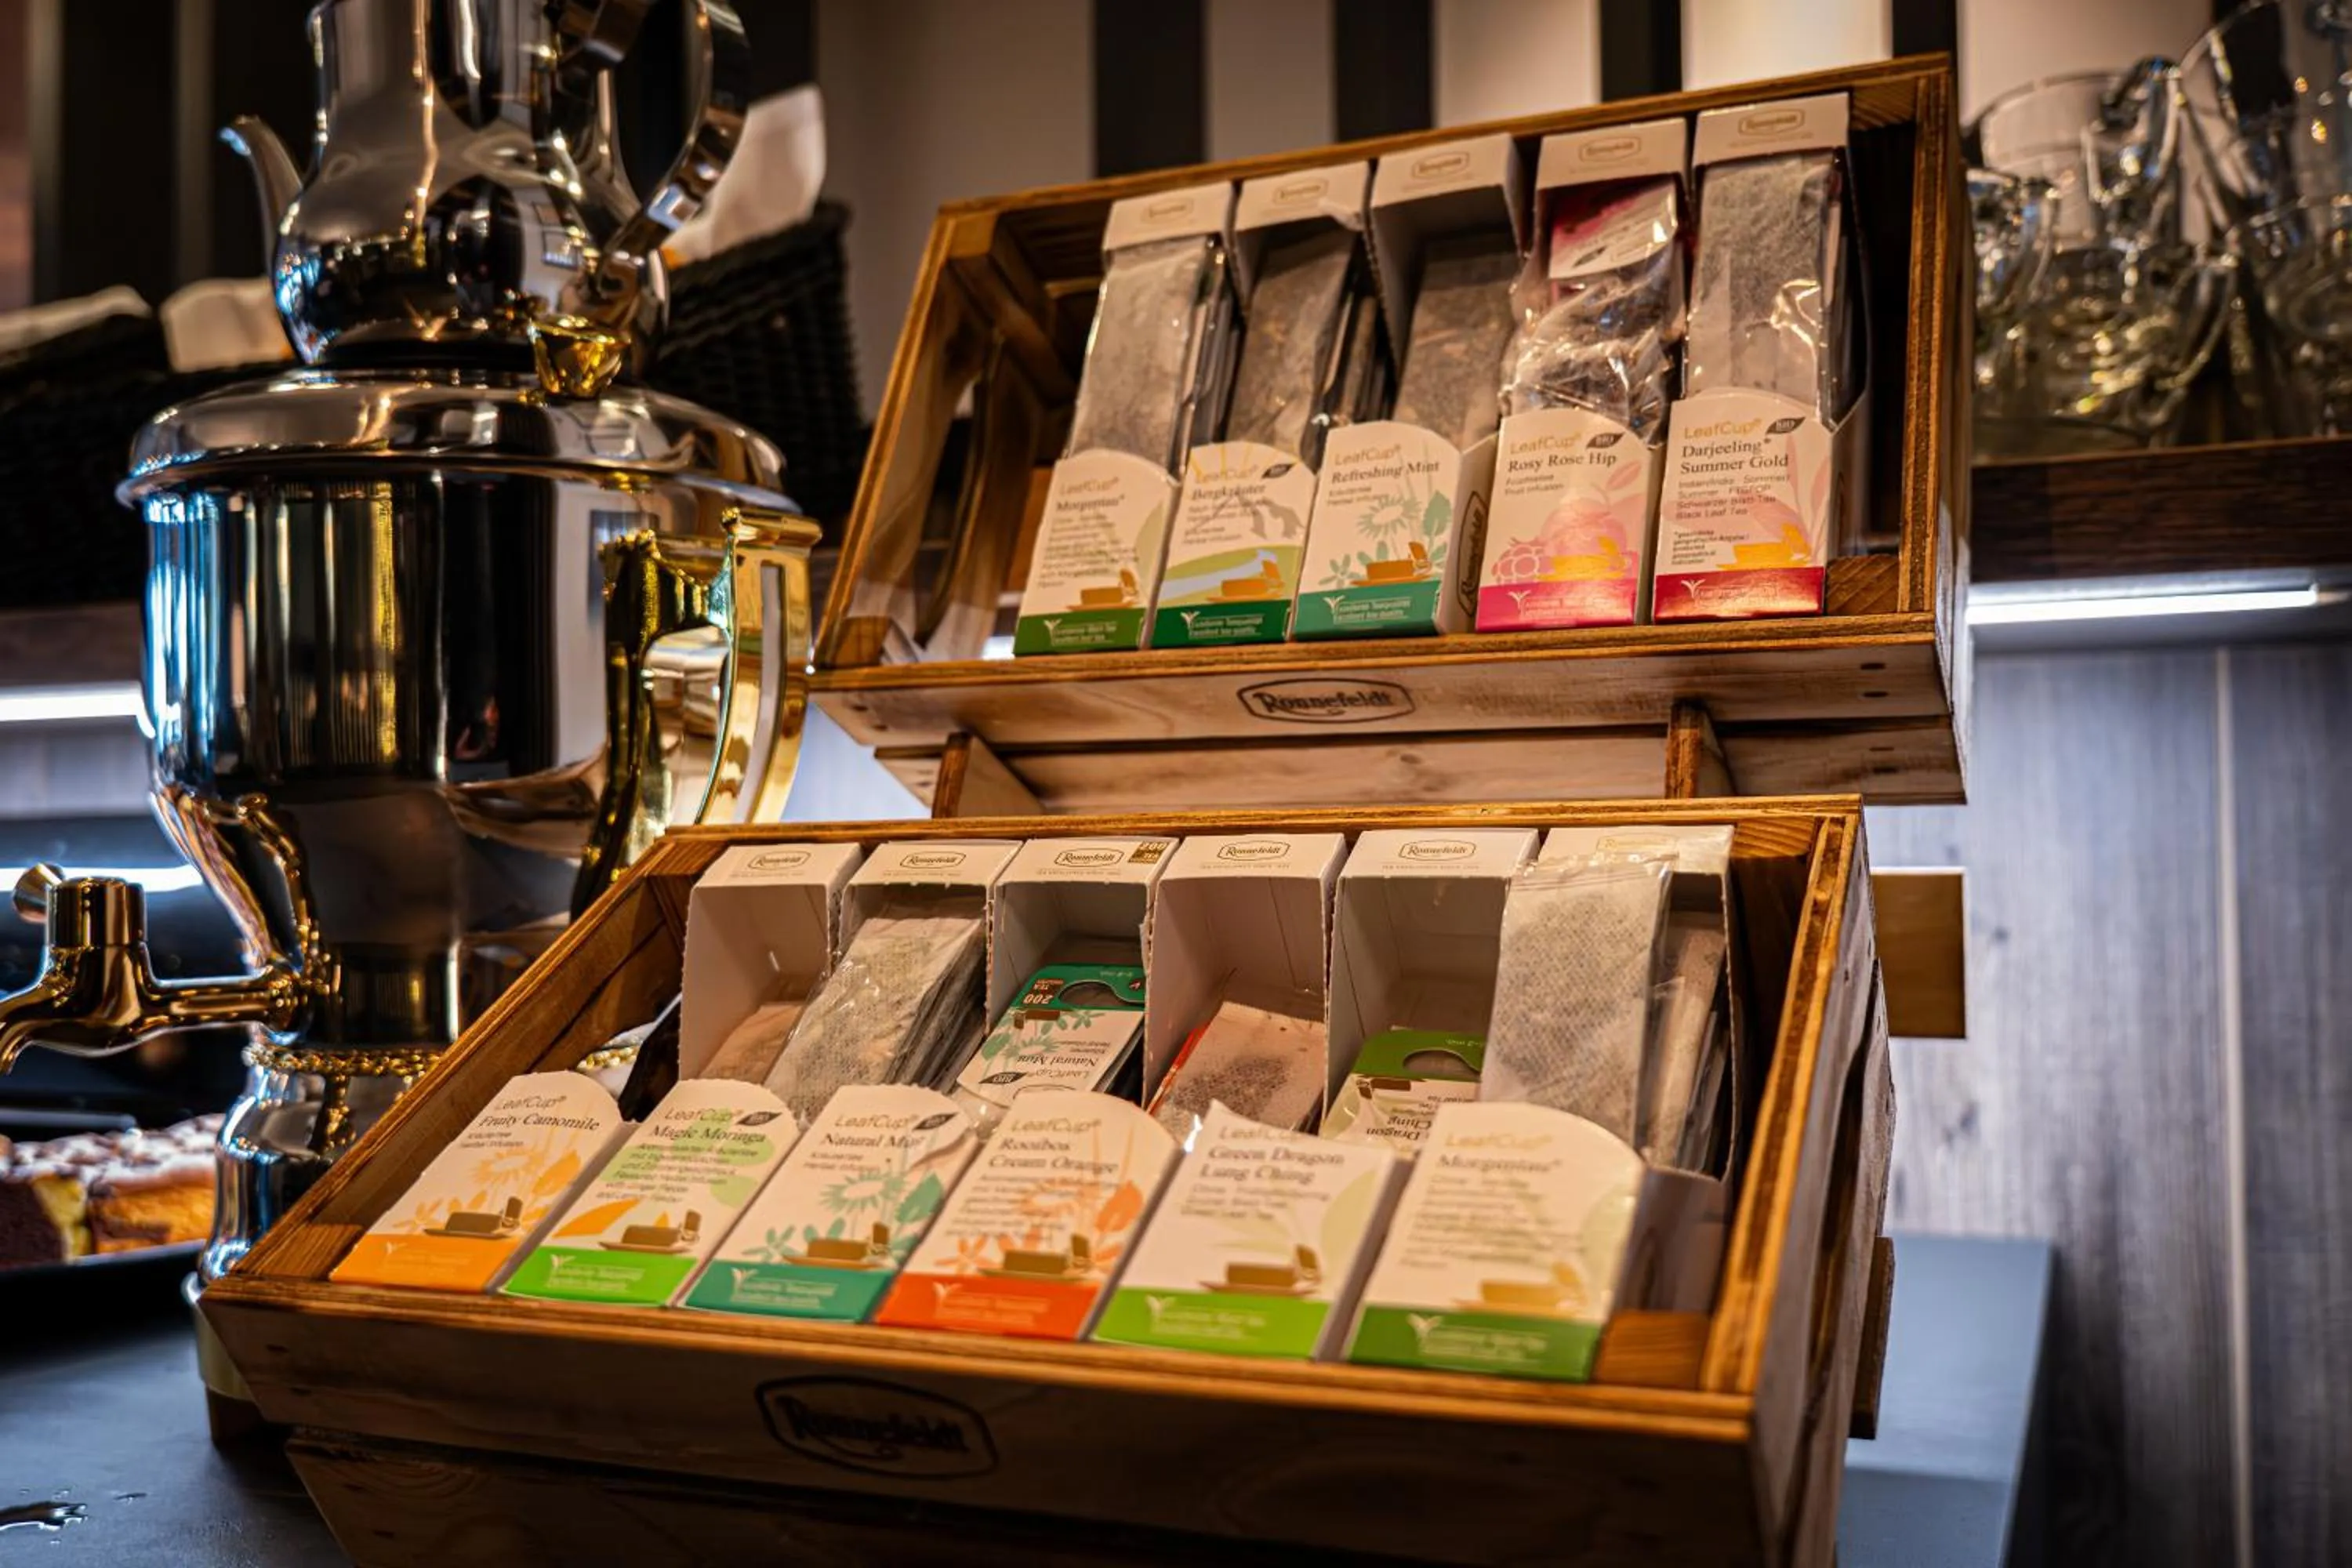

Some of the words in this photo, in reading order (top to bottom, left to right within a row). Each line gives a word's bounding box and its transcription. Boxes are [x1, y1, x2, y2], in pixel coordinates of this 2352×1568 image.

[1508, 459, 1544, 472] Rosy
[1548, 455, 1584, 467] Rose
[1588, 452, 1617, 467] Hip
[1680, 460, 1744, 474] Summer
[1749, 453, 1789, 469] Gold
[1332, 466, 1403, 484] Refreshing
[1406, 461, 1440, 475] Mint
[1252, 691, 1394, 715] Ronnefeldt
[1062, 851, 1115, 863] Ronnefeldt
[1225, 845, 1283, 858] Ronnefeldt
[1407, 843, 1468, 857] Ronnefeldt
[1022, 993, 1054, 1004] 200
[523, 1113, 600, 1131] Camomile
[1387, 1115, 1432, 1130] Ching
[650, 1124, 698, 1141] Magic
[700, 1127, 766, 1144] Moringa
[822, 1133, 883, 1147] Natural
[1367, 1127, 1420, 1142] Dragon
[989, 1155, 1047, 1168] Cream
[1051, 1156, 1119, 1174] Orange
[1209, 1145, 1266, 1160] Green
[1271, 1147, 1345, 1166] Dragon
[1255, 1164, 1316, 1185] Ching
